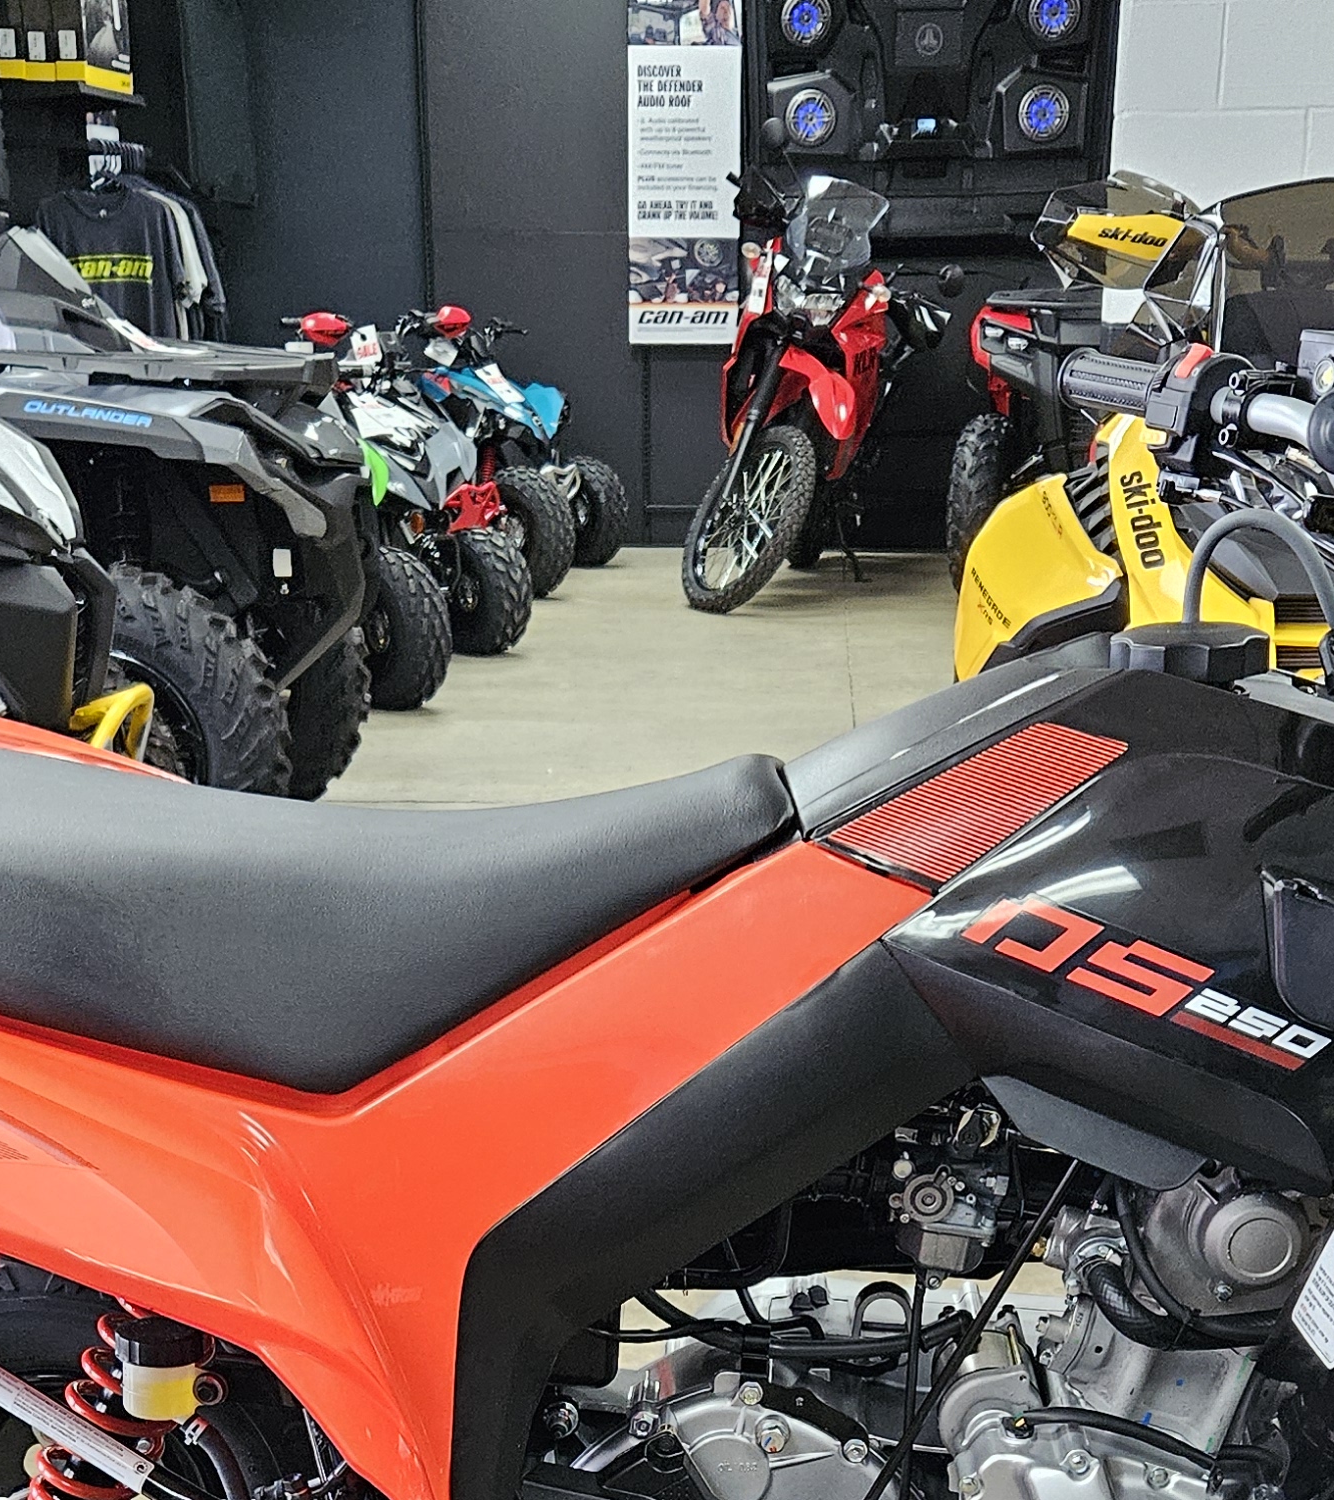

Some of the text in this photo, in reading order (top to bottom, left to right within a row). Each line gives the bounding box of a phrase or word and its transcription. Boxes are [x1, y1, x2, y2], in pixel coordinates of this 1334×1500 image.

[637, 65, 681, 77] DISCOVER
[638, 80, 703, 92] THE DEFENDER
[637, 95, 692, 107] AUDIO ROOF
[1098, 227, 1168, 248] ski-doo
[638, 310, 729, 325] can-am
[357, 342, 378, 359] SALE
[23, 399, 153, 428] OUTLANDER
[1119, 470, 1166, 570] ski-doo
[970, 567, 1011, 629] RENEGADE
[1184, 986, 1331, 1060] 250
